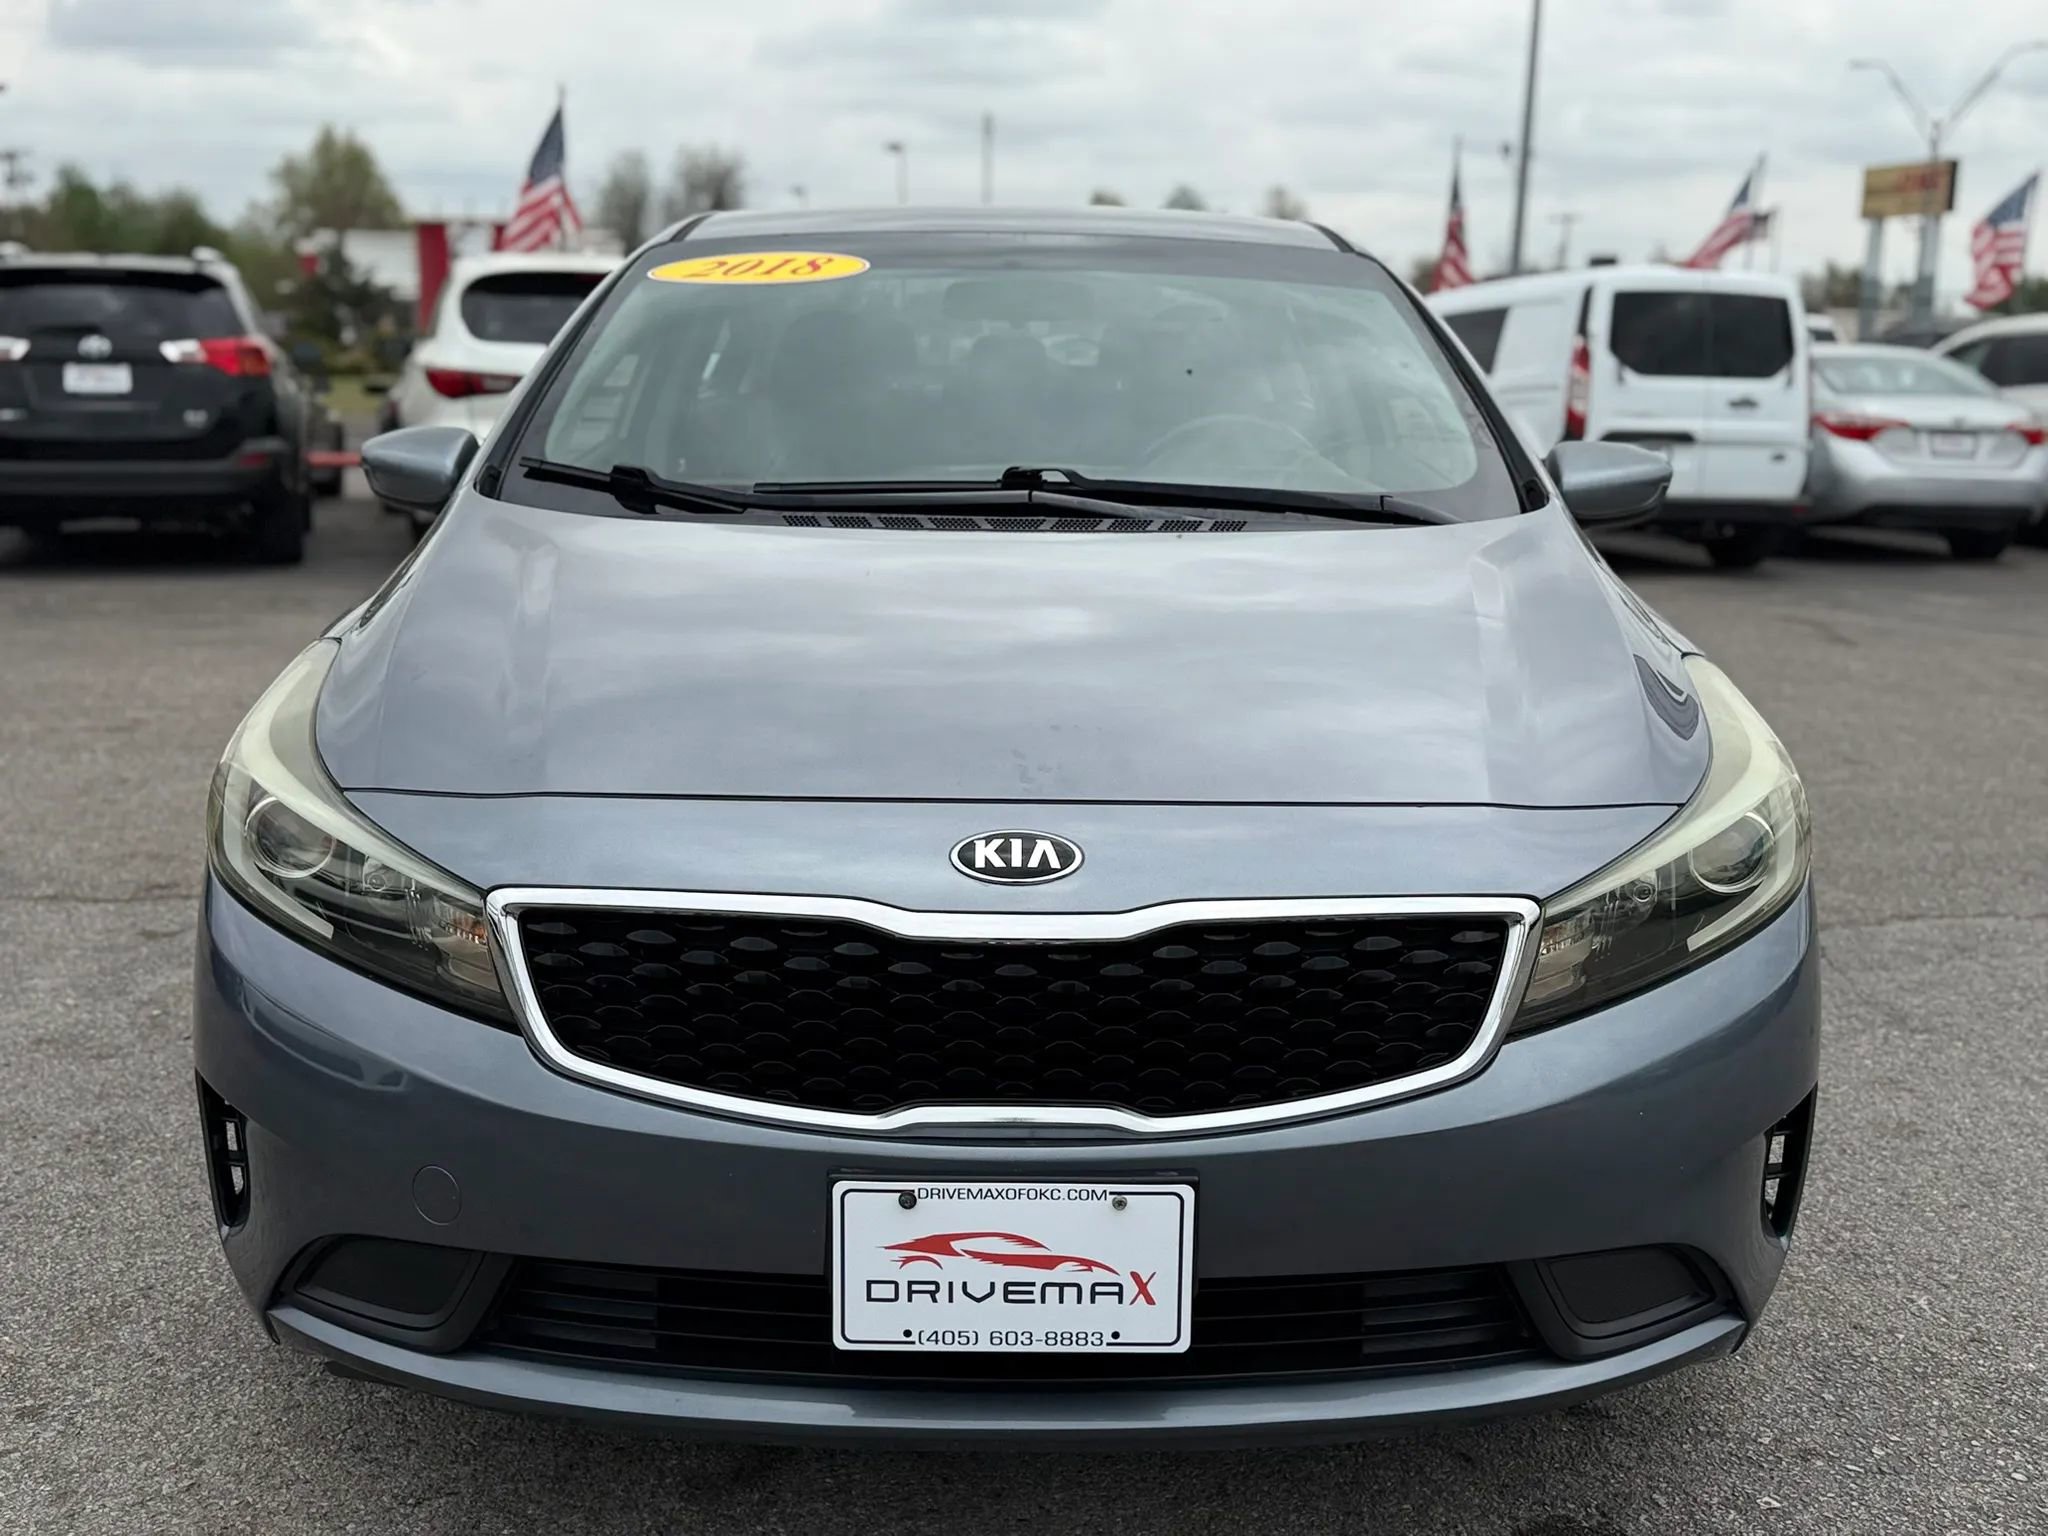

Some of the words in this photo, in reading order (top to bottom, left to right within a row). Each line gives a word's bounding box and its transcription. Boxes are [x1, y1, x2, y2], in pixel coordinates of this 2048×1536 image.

[682, 257, 834, 278] 2018
[973, 838, 1062, 869] KIA
[917, 1187, 1108, 1201] DRIVEMAXOFOKC.COM
[865, 1271, 1157, 1306] DRIVEMAX
[917, 1330, 979, 1346] (405)
[989, 1330, 1105, 1347] 603-8883
